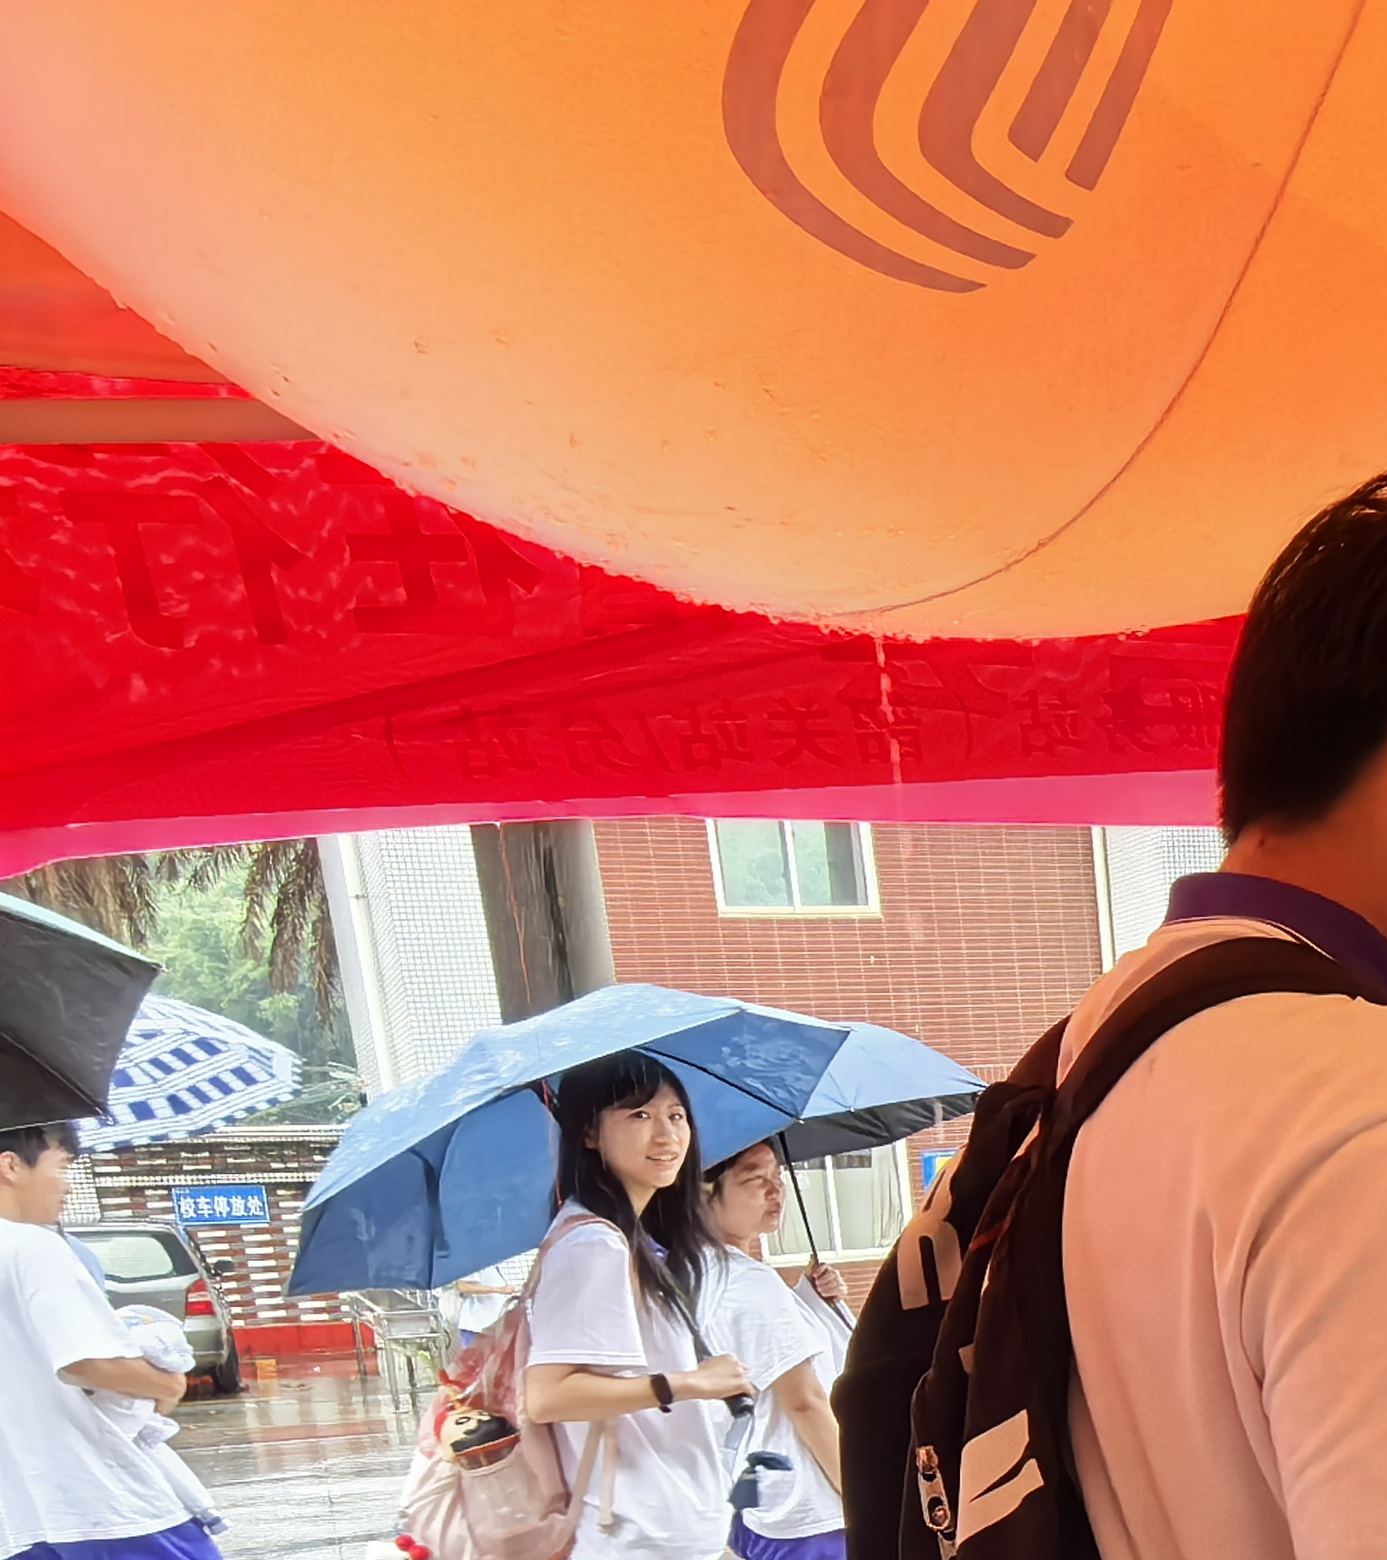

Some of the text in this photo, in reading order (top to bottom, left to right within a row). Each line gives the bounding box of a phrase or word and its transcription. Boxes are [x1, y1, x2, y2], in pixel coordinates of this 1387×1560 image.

[178, 1194, 267, 1219] 校车停放处
